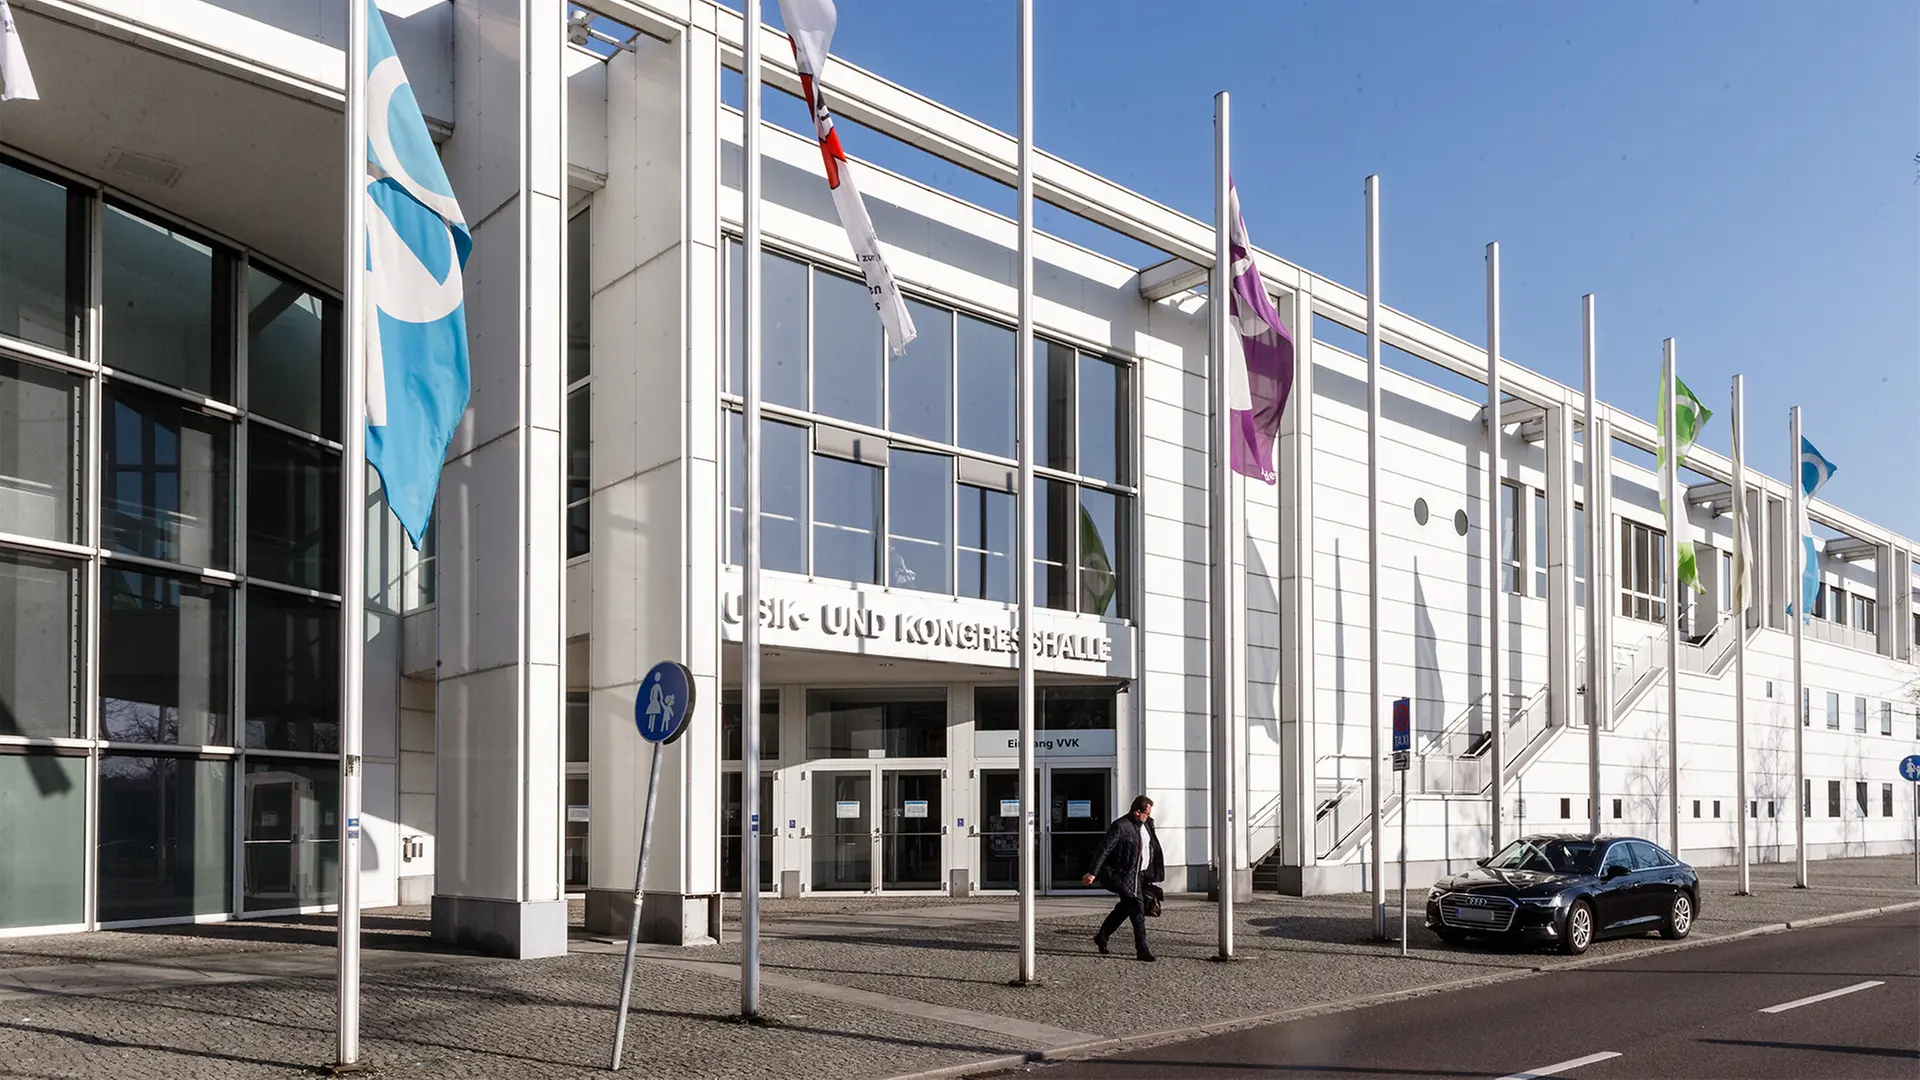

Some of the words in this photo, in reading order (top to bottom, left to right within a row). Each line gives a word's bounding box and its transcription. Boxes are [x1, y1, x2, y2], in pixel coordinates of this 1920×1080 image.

[722, 591, 811, 631] USIK-
[821, 604, 891, 639] UND
[895, 613, 1113, 662] KONGRESSHALLE
[1007, 738, 1054, 750] Eiang
[1055, 738, 1080, 748] VVK
[1394, 734, 1409, 747] TAXI
